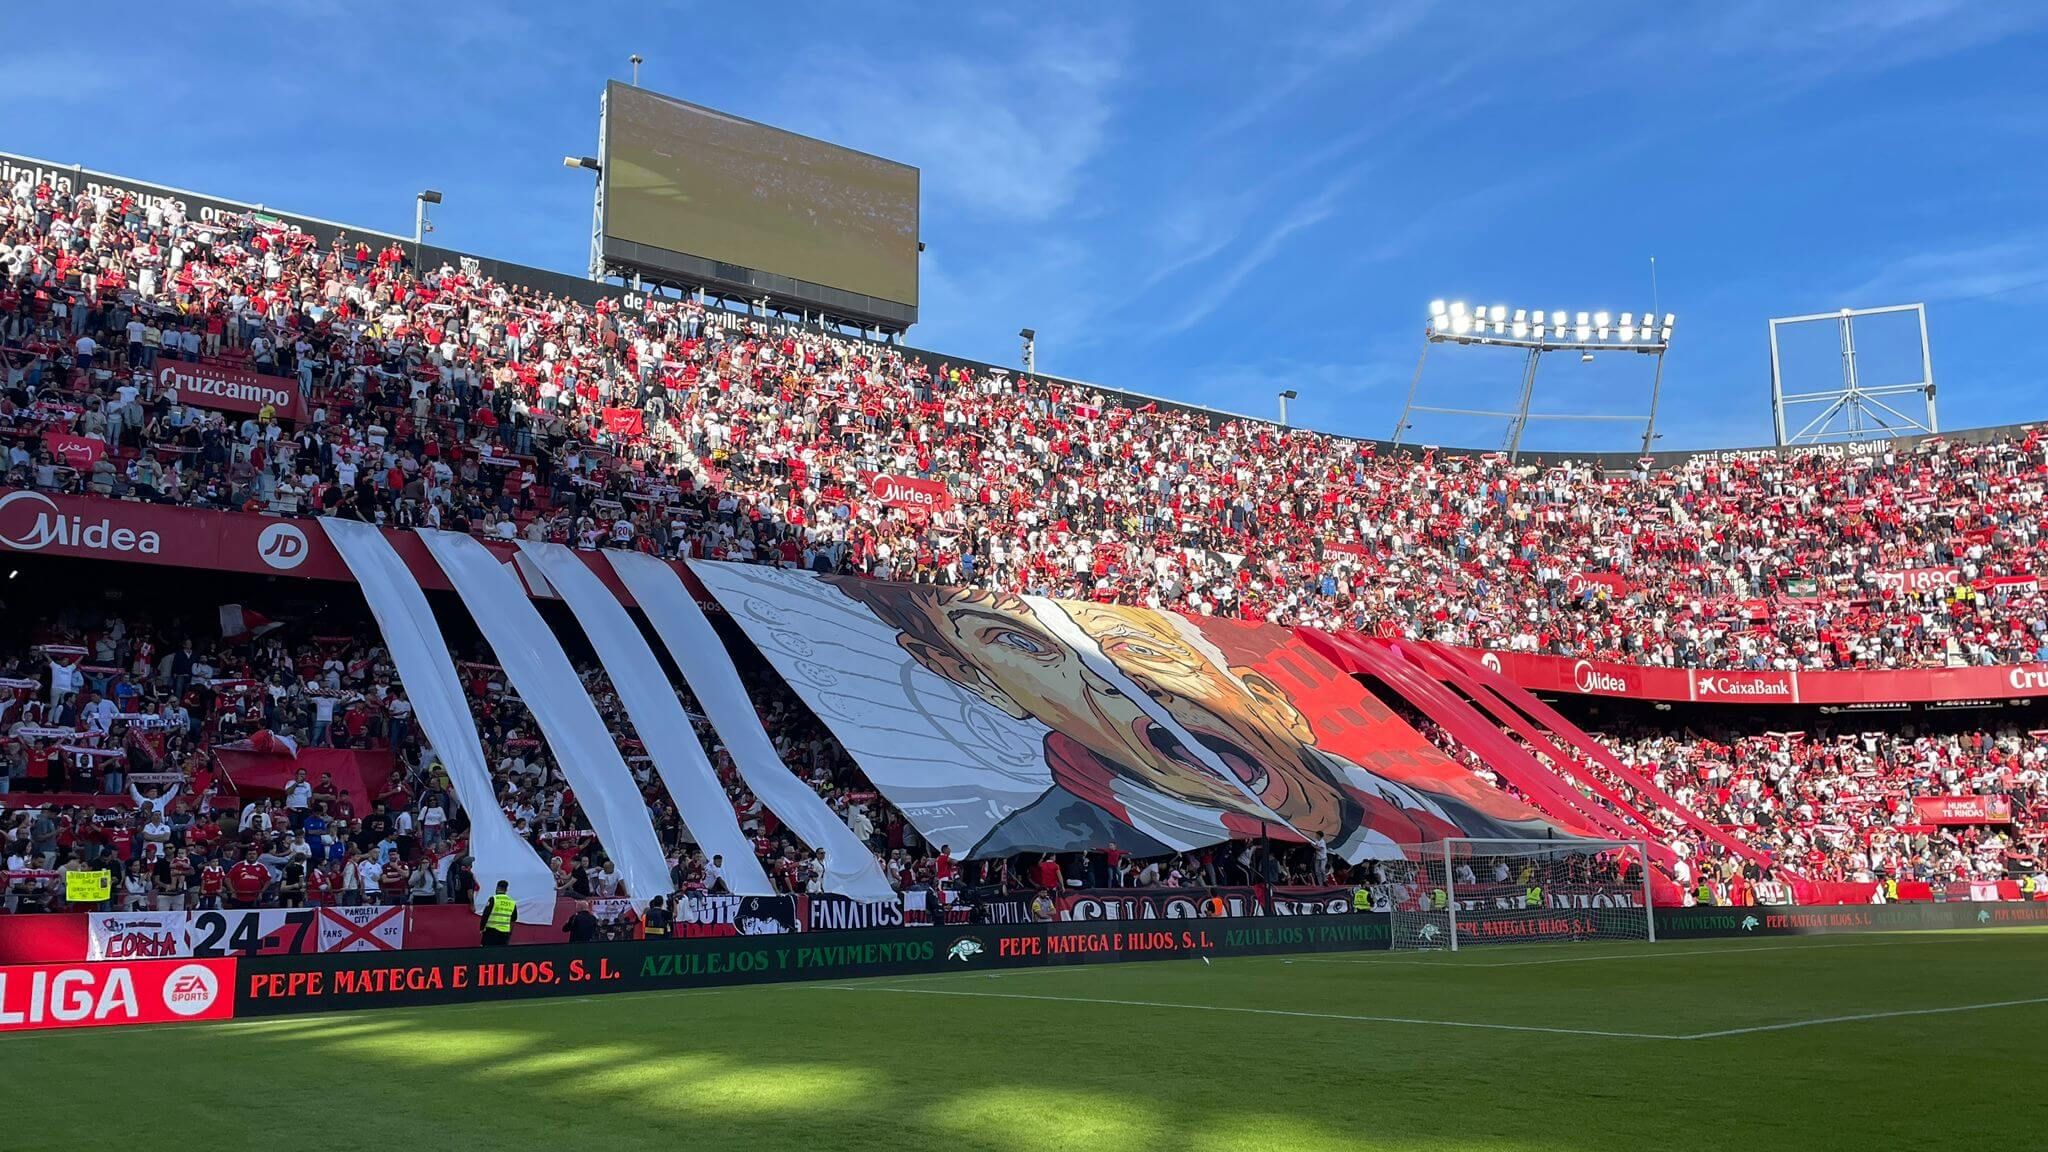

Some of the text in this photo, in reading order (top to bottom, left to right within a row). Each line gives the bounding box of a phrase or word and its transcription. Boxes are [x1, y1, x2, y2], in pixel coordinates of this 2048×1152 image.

[623, 292, 643, 311] de
[160, 366, 290, 407] Cruzcampo
[881, 484, 933, 505] Midea
[17, 512, 160, 554] Midea
[264, 533, 302, 557] JD
[1583, 670, 1627, 692] Midea
[1717, 677, 1790, 695] CaixaBank
[1942, 809, 1985, 818] TE RINDAS
[1947, 801, 1977, 810] NUNCA
[354, 916, 369, 924] CITY
[810, 901, 902, 929] FANATICS
[1672, 915, 1736, 930] PAVIMENTOS
[1766, 915, 1789, 929] PEPE
[192, 911, 315, 956] 24-7
[323, 930, 342, 938] FANS
[383, 927, 398, 936] SFC
[1224, 928, 1303, 947] AZULEJOS
[1307, 928, 1317, 942] Y
[105, 932, 177, 958] CORIA
[1000, 936, 1042, 957] PEPE
[1047, 933, 1110, 954] MATEGA
[1113, 932, 1123, 952] E
[1127, 931, 1176, 952] HIJOS,
[1182, 931, 1197, 949] S.
[1201, 931, 1214, 948] L.
[640, 950, 769, 978] AZULEJOS
[777, 949, 791, 970] Y
[796, 941, 935, 969] PAVIMENTOS
[173, 975, 208, 993] EA
[249, 958, 621, 999] PEPE MATEGA E HIJOS, S. L.
[0, 968, 139, 1024] LIGA
[171, 992, 209, 1002] SPORTS
